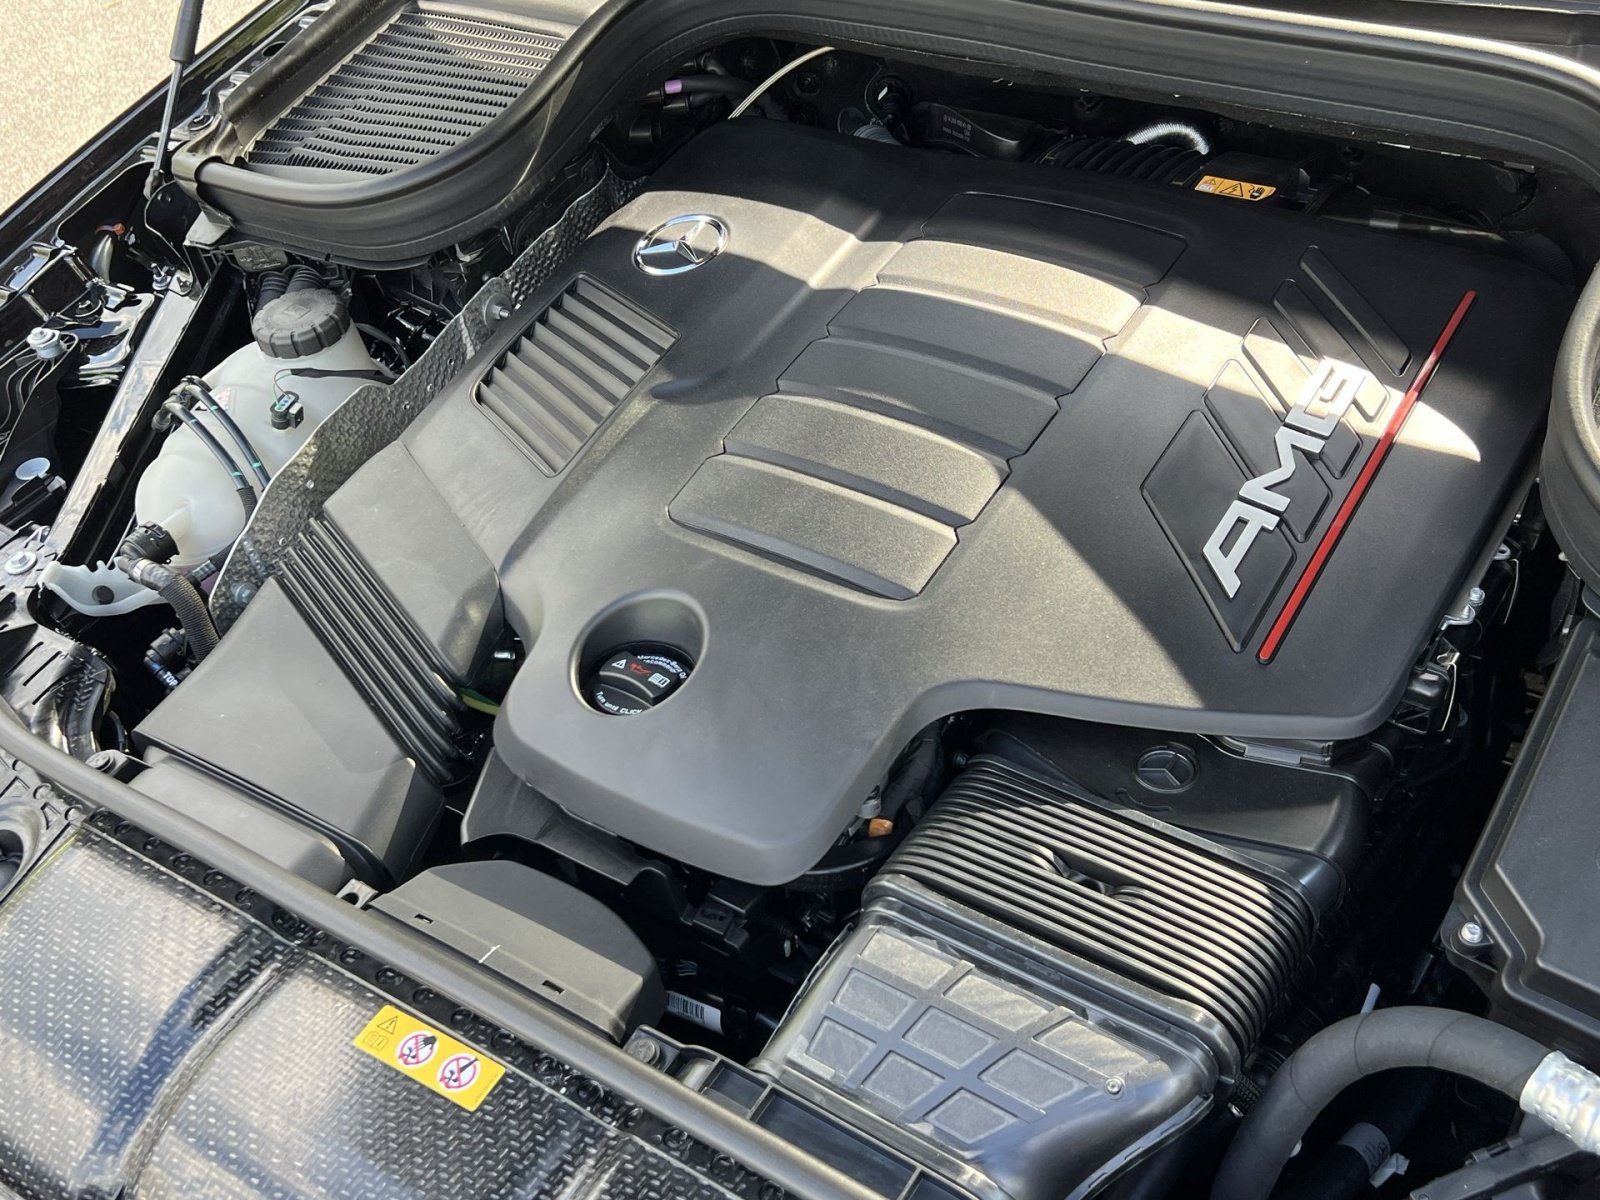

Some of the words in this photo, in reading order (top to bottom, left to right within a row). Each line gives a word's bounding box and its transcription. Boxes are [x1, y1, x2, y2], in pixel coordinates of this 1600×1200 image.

[1202, 358, 1366, 599] AMG
[637, 655, 683, 672] Mercedes-Benz
[163, 671, 179, 686] TOP
[596, 691, 606, 704] Turn
[604, 701, 619, 711] until
[619, 707, 643, 715] CLICK
